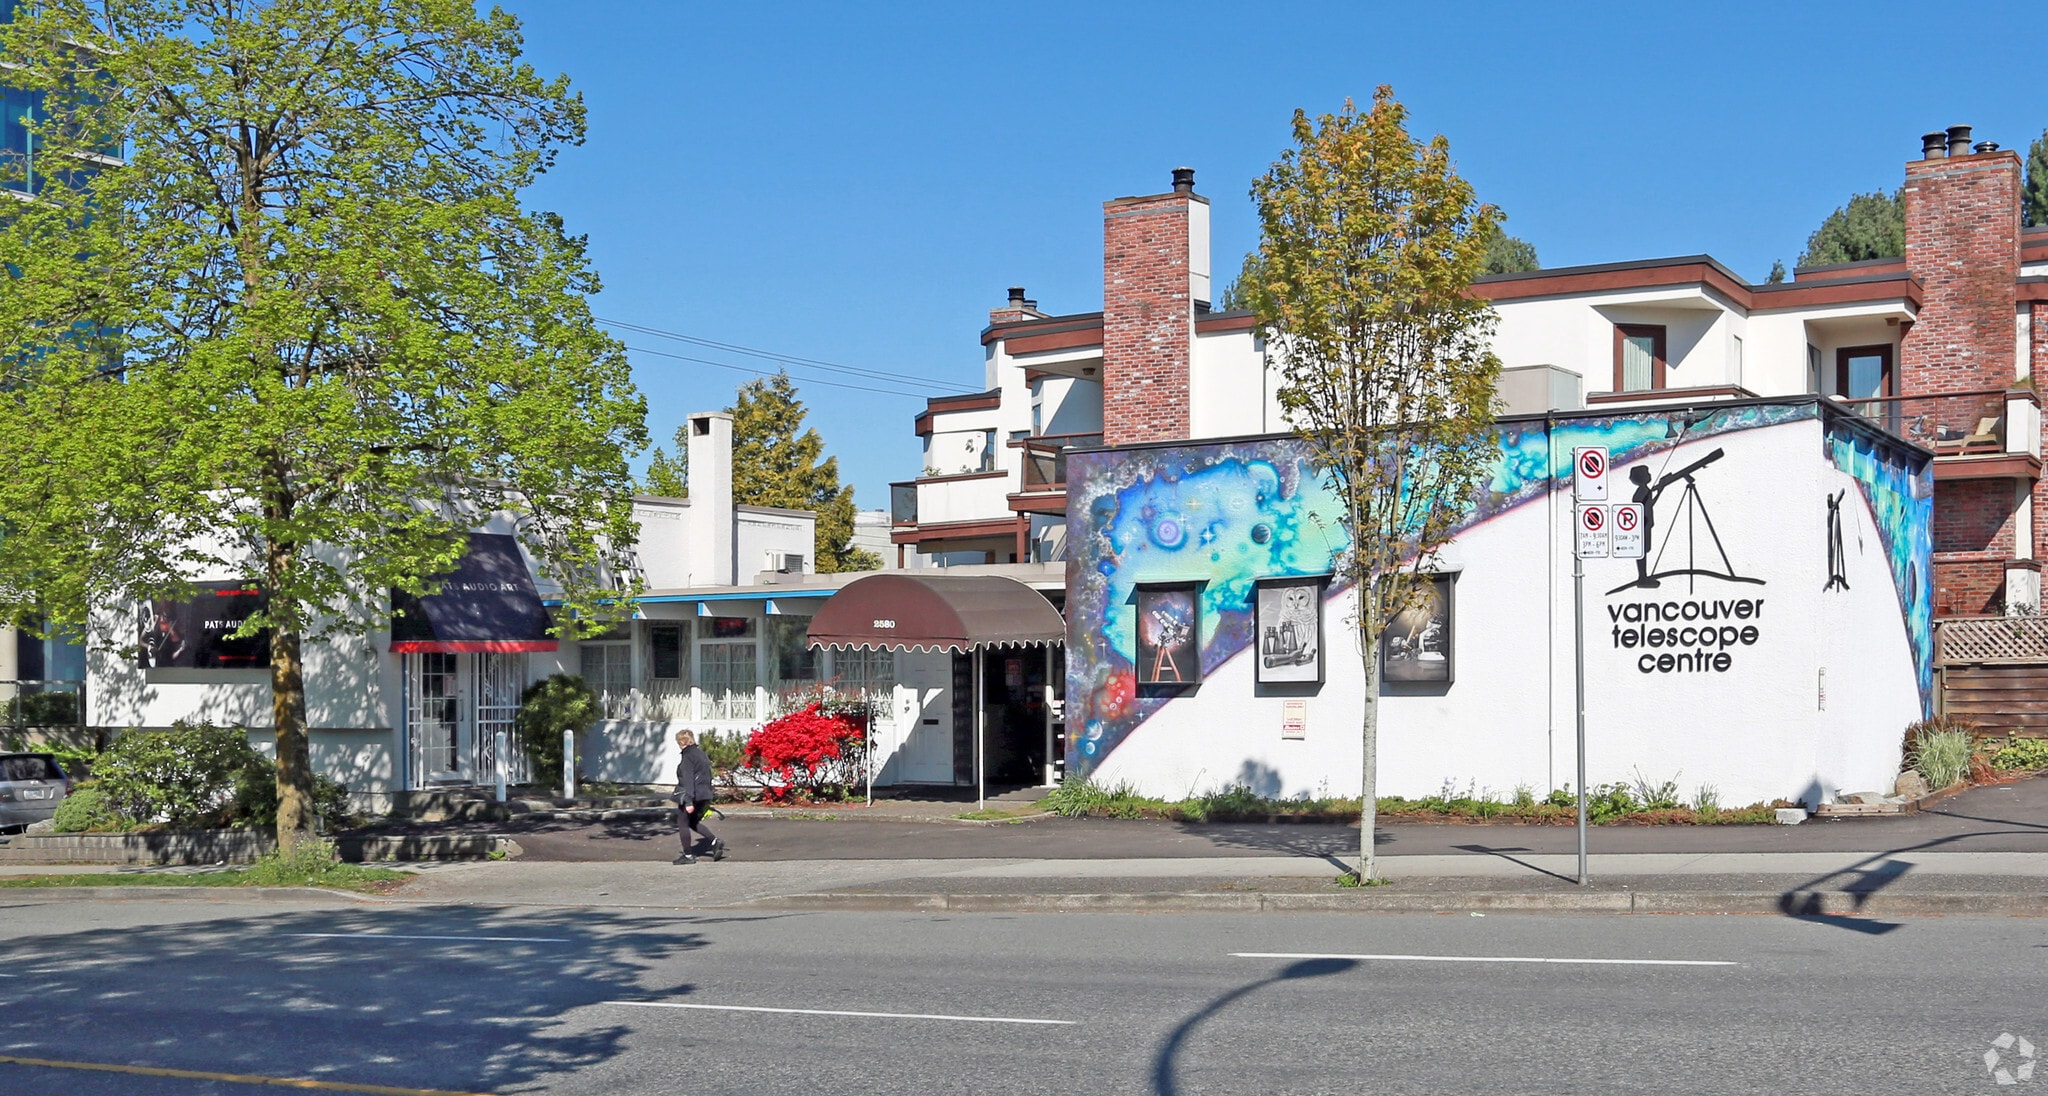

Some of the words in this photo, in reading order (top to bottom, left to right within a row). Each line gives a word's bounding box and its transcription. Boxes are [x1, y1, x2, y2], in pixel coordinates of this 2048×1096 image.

[462, 582, 498, 592] AUDIO
[500, 583, 520, 592] ART
[1607, 598, 1764, 623] vancouver
[204, 620, 224, 629] PATS
[873, 619, 895, 629] 2580
[1611, 623, 1760, 651] telescope
[1637, 648, 1732, 674] centre
